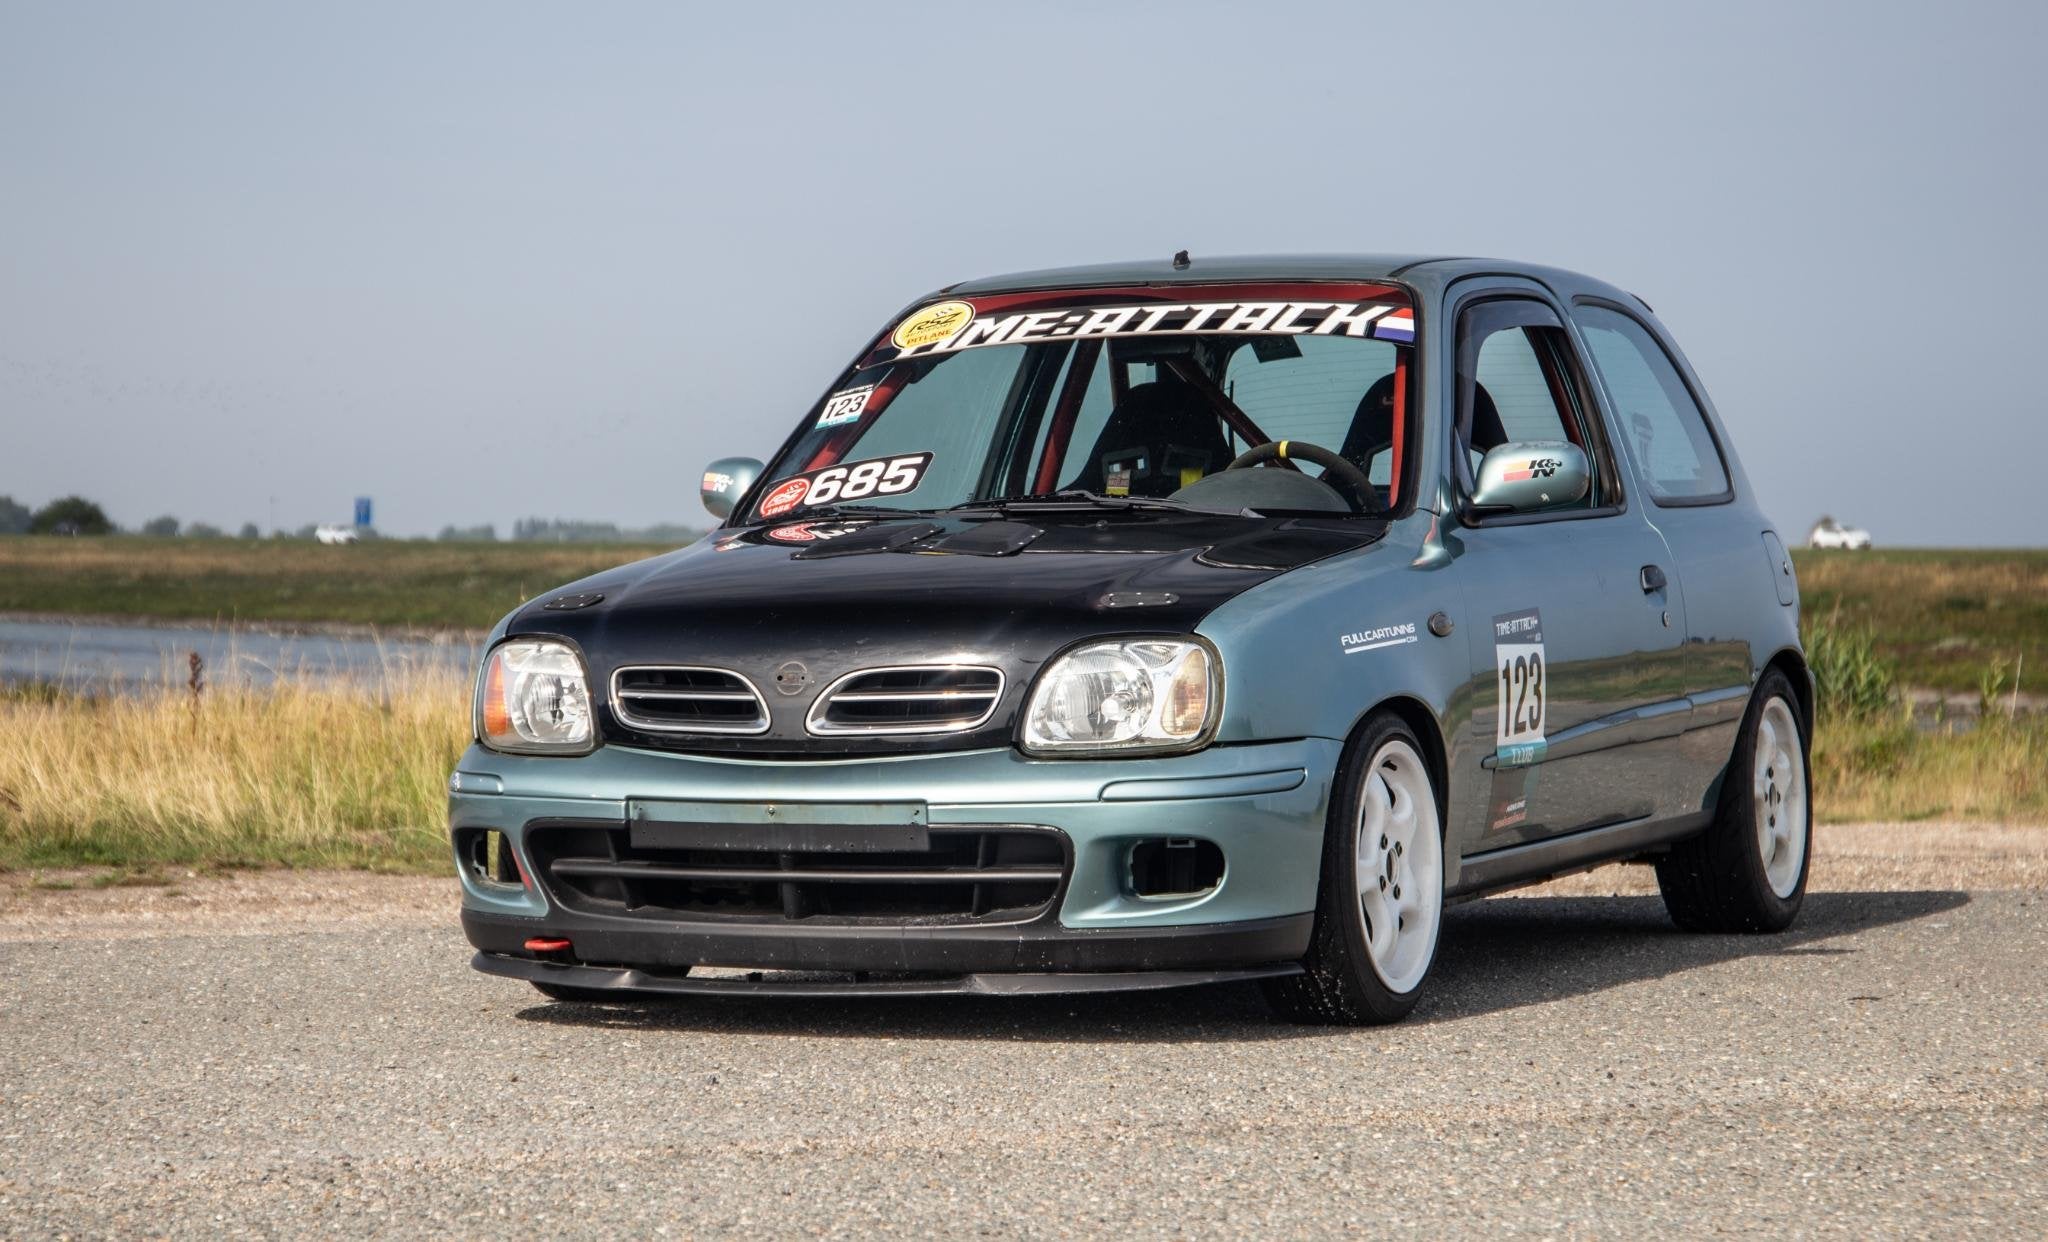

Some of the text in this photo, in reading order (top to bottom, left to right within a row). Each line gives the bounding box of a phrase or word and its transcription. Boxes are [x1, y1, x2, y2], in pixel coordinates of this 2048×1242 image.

[826, 395, 866, 419] 123
[1528, 458, 1562, 478] K&N
[803, 456, 924, 505] 685
[1341, 623, 1415, 646] FULLCARTUNING
[1502, 652, 1542, 737] 123
